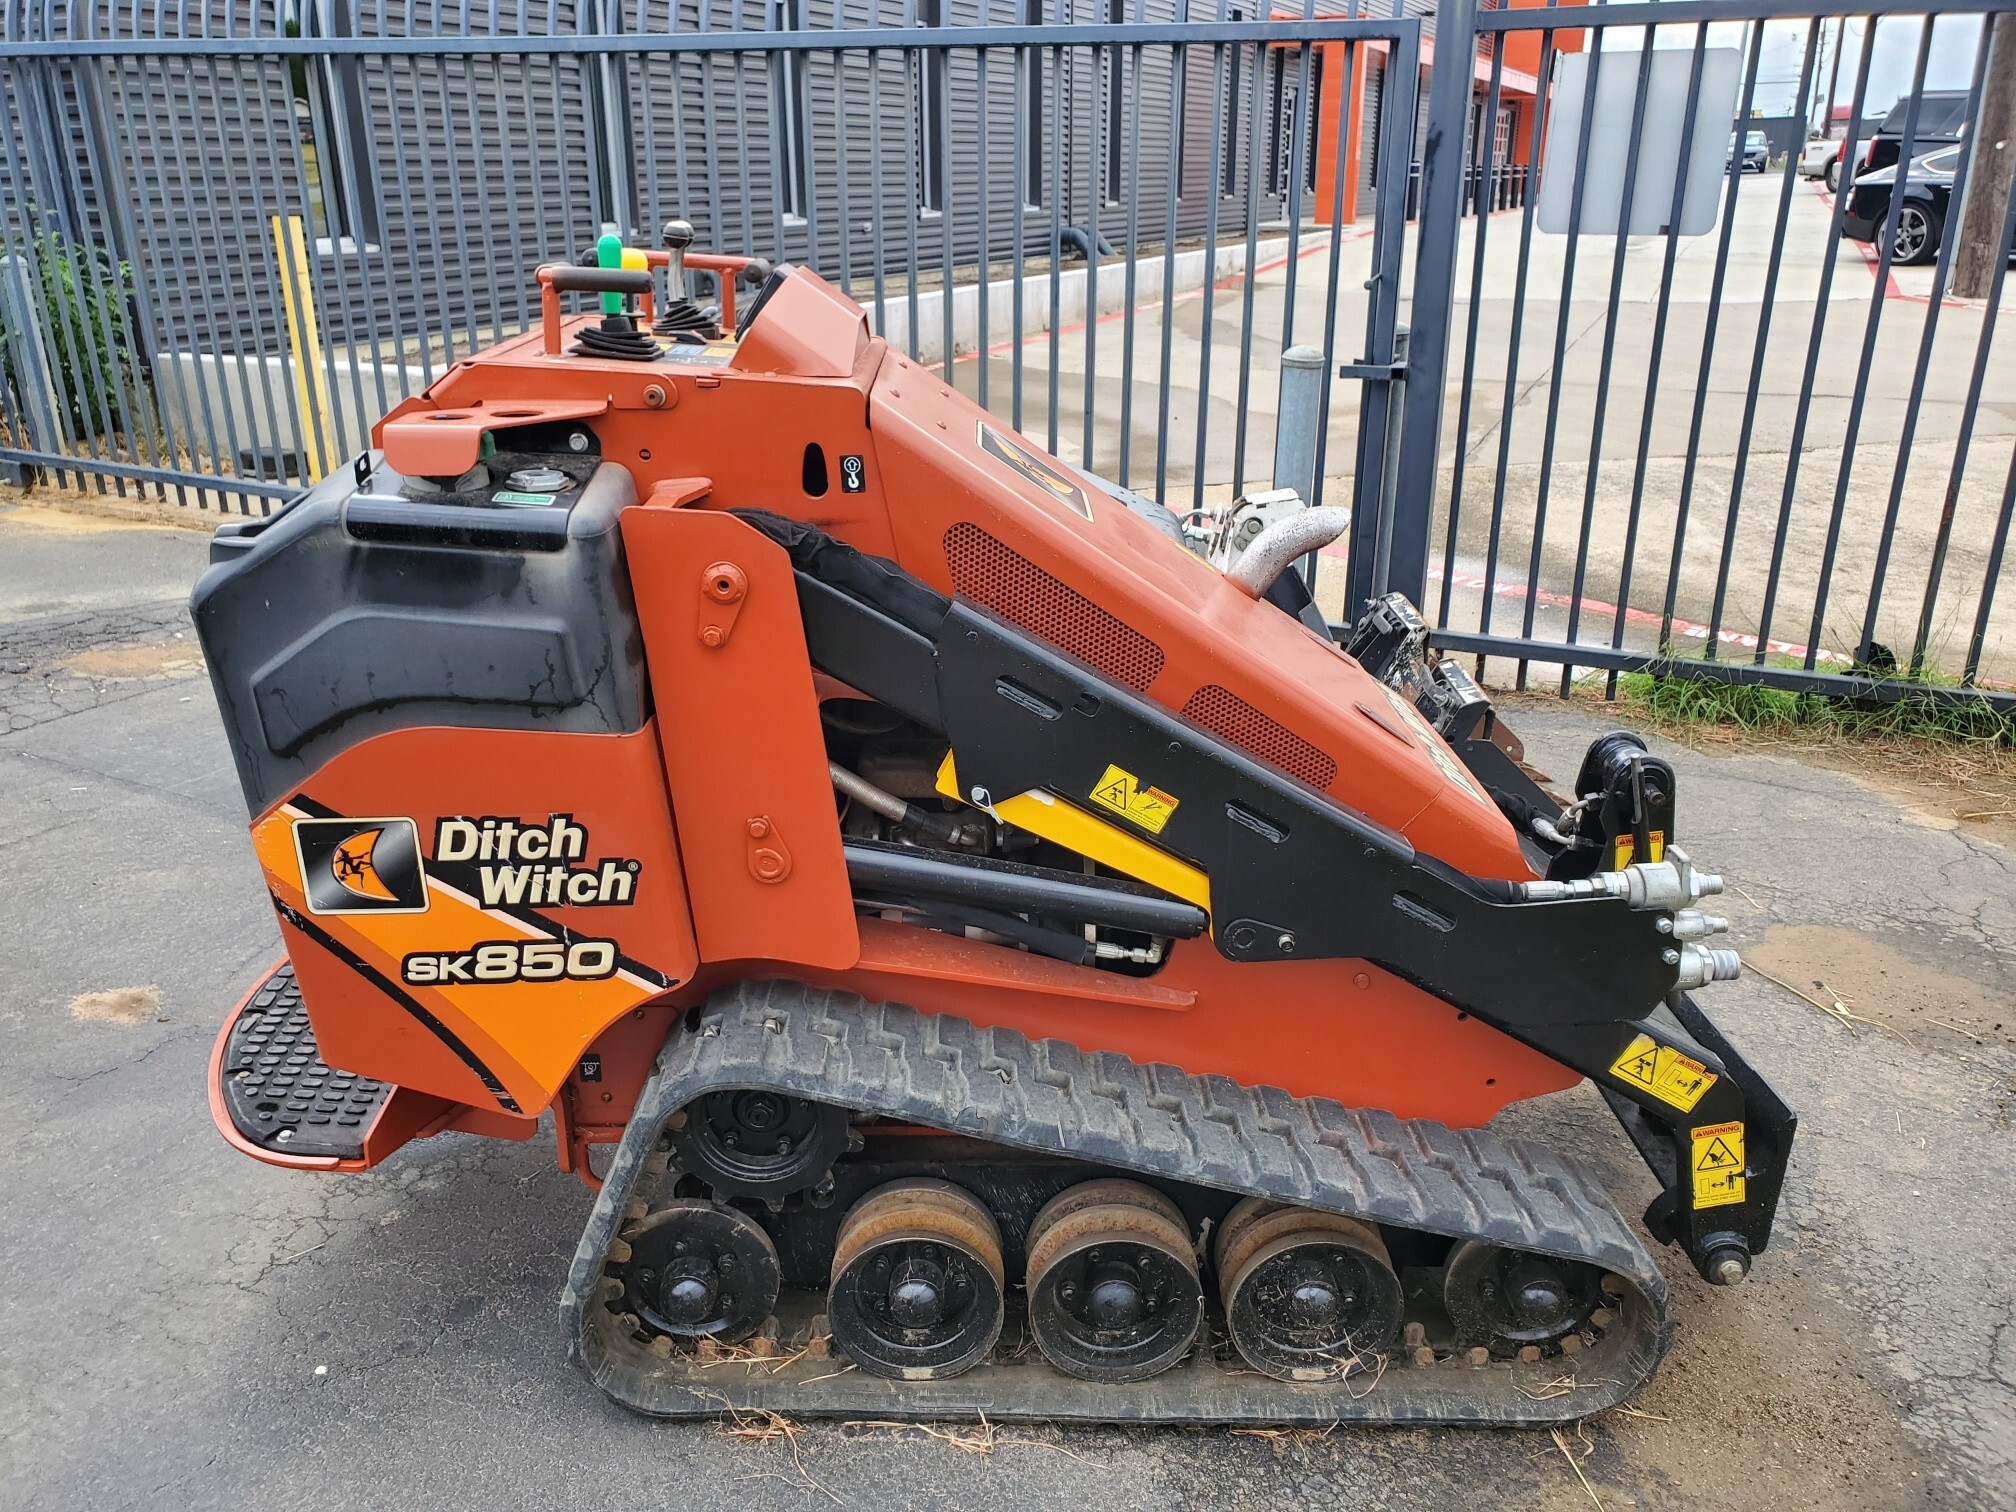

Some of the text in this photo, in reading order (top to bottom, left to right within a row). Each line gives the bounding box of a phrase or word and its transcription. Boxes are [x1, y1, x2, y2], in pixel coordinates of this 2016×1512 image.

[437, 818, 584, 862] Ditch
[407, 942, 616, 981] SK850
[1702, 1124, 1740, 1137] WARNING
